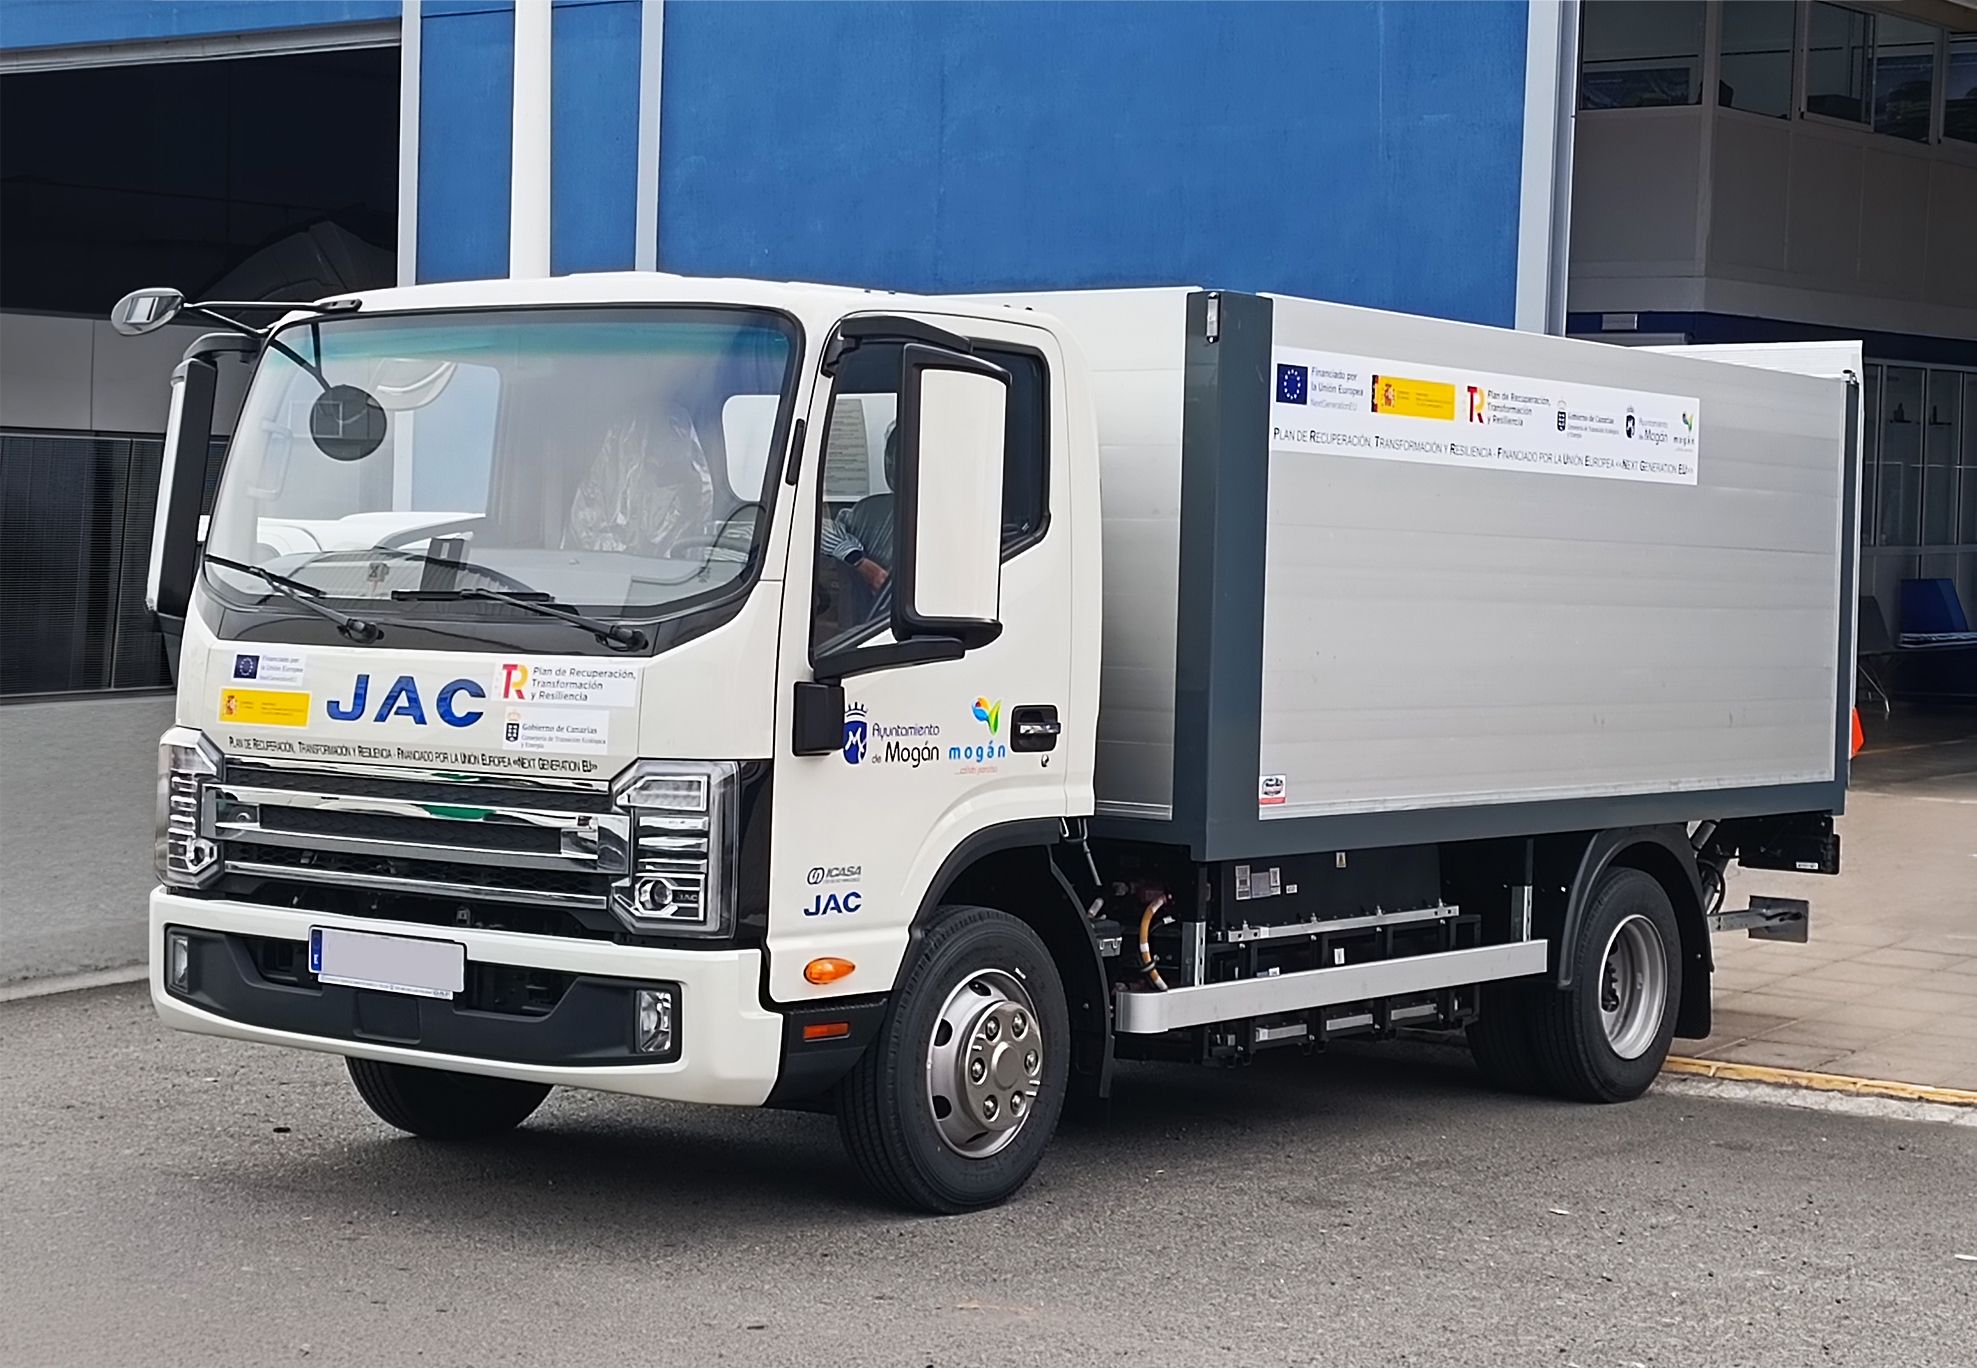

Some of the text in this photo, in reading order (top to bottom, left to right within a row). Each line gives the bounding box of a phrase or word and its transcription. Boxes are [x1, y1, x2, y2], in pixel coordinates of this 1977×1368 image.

[1273, 427, 1295, 441] PLAN
[1297, 431, 1308, 442] DE
[1539, 452, 1553, 463] POR
[533, 667, 636, 680] Plan de Recuperación,
[532, 679, 603, 690] Transformación
[326, 674, 486, 728] JAC
[539, 691, 588, 701] Resiliencia
[522, 723, 597, 734] Gobierno de Canarias
[872, 723, 940, 740] Ayuntamiento
[435, 751, 448, 762] POR
[871, 740, 940, 768] de Mogán
[949, 740, 1006, 763] mogán
[826, 866, 861, 878] ICASA
[803, 891, 862, 916] JAC
